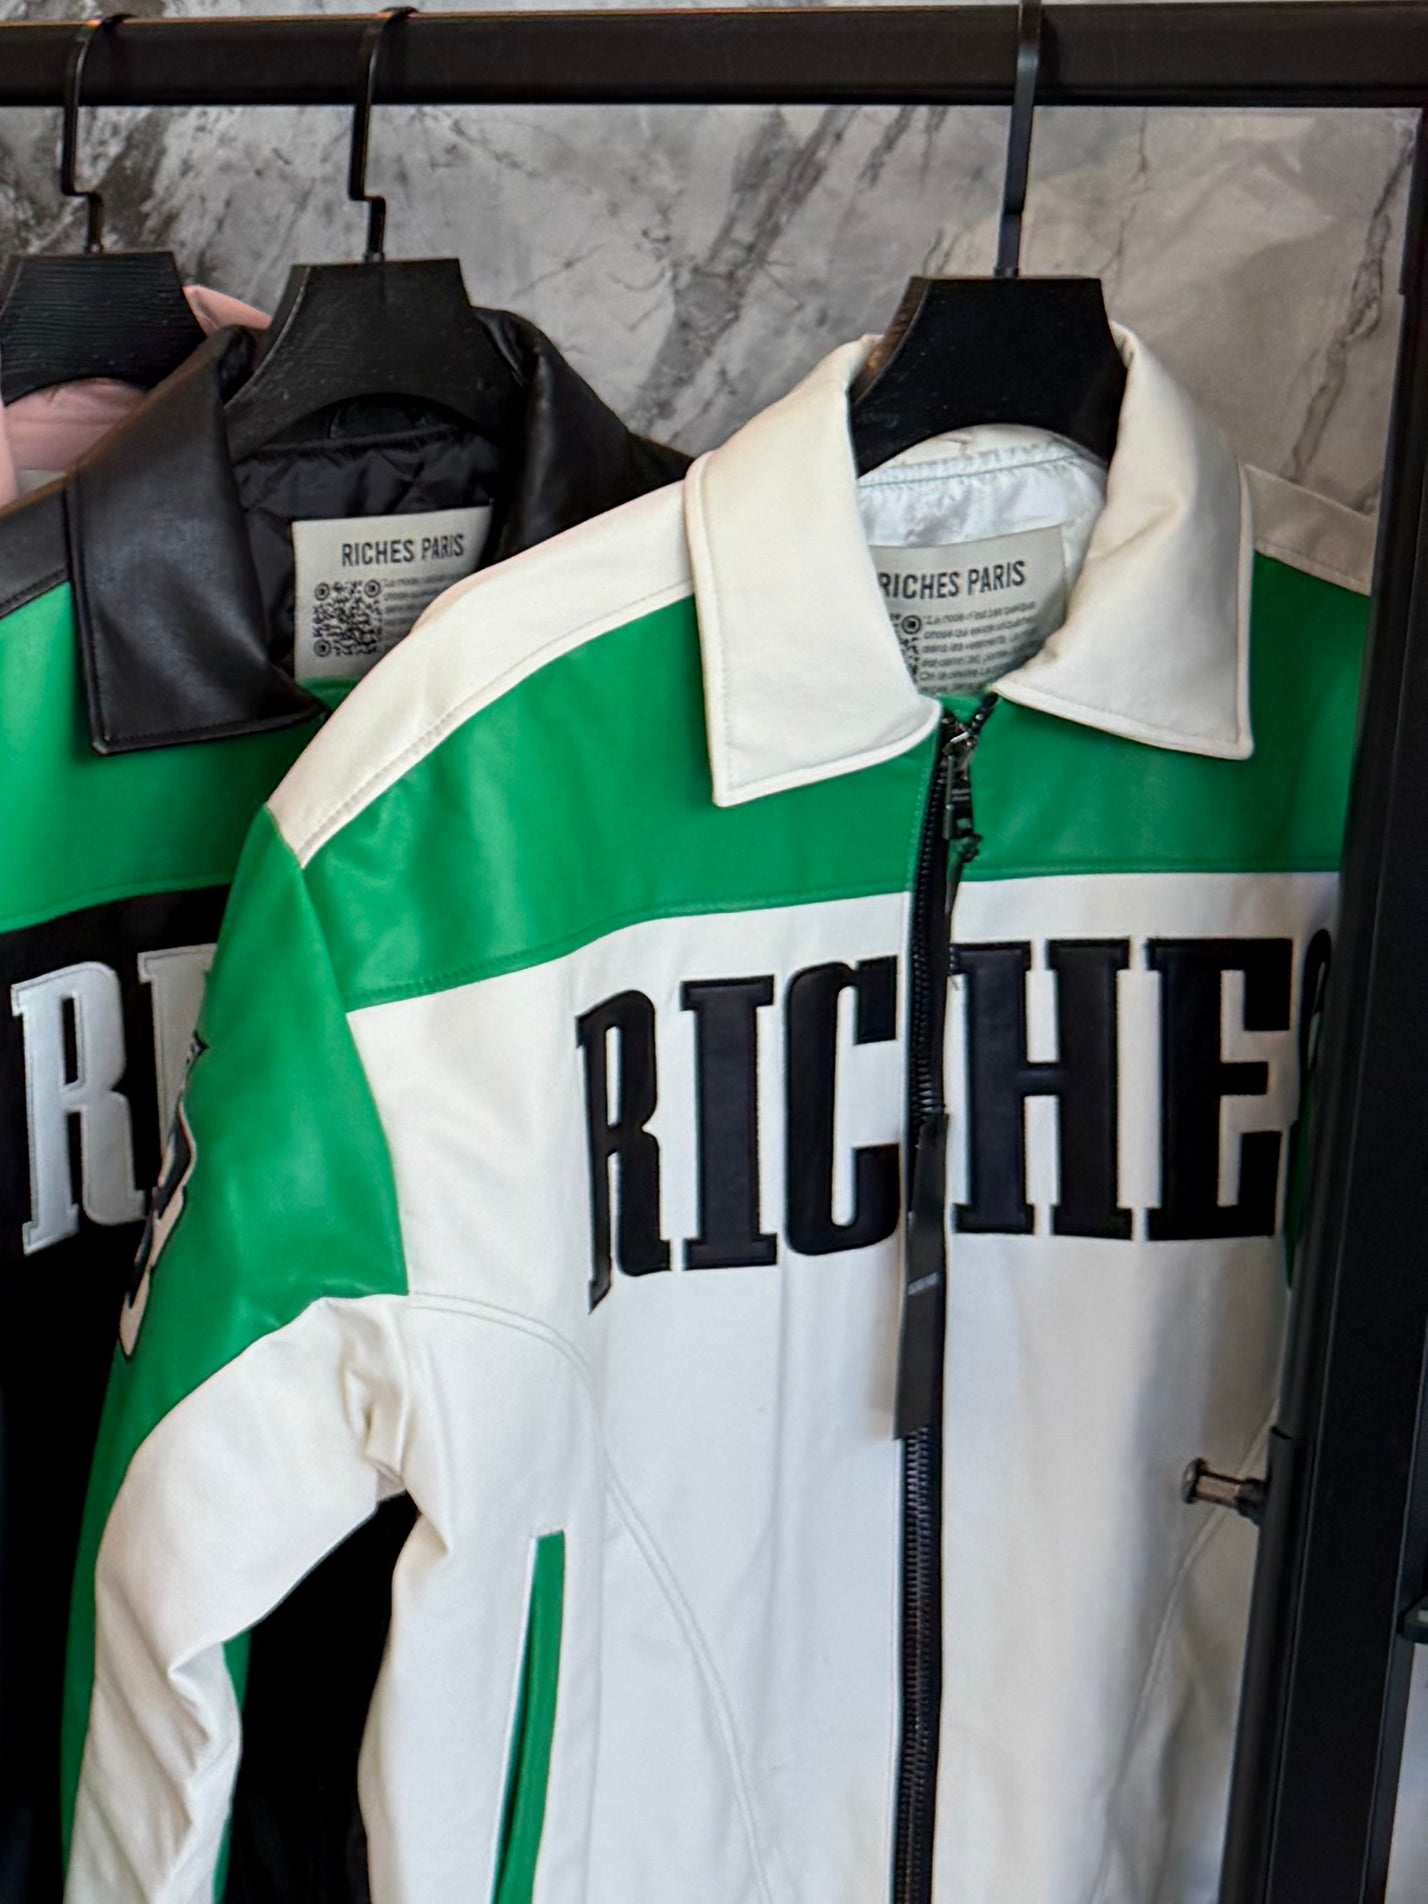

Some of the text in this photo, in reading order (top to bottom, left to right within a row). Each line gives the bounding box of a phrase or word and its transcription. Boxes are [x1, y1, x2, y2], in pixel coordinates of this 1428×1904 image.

[341, 533, 465, 567] RICHES PARIS
[877, 560, 1026, 599] RICHES PARIS
[575, 928, 1332, 1314] RICHE
